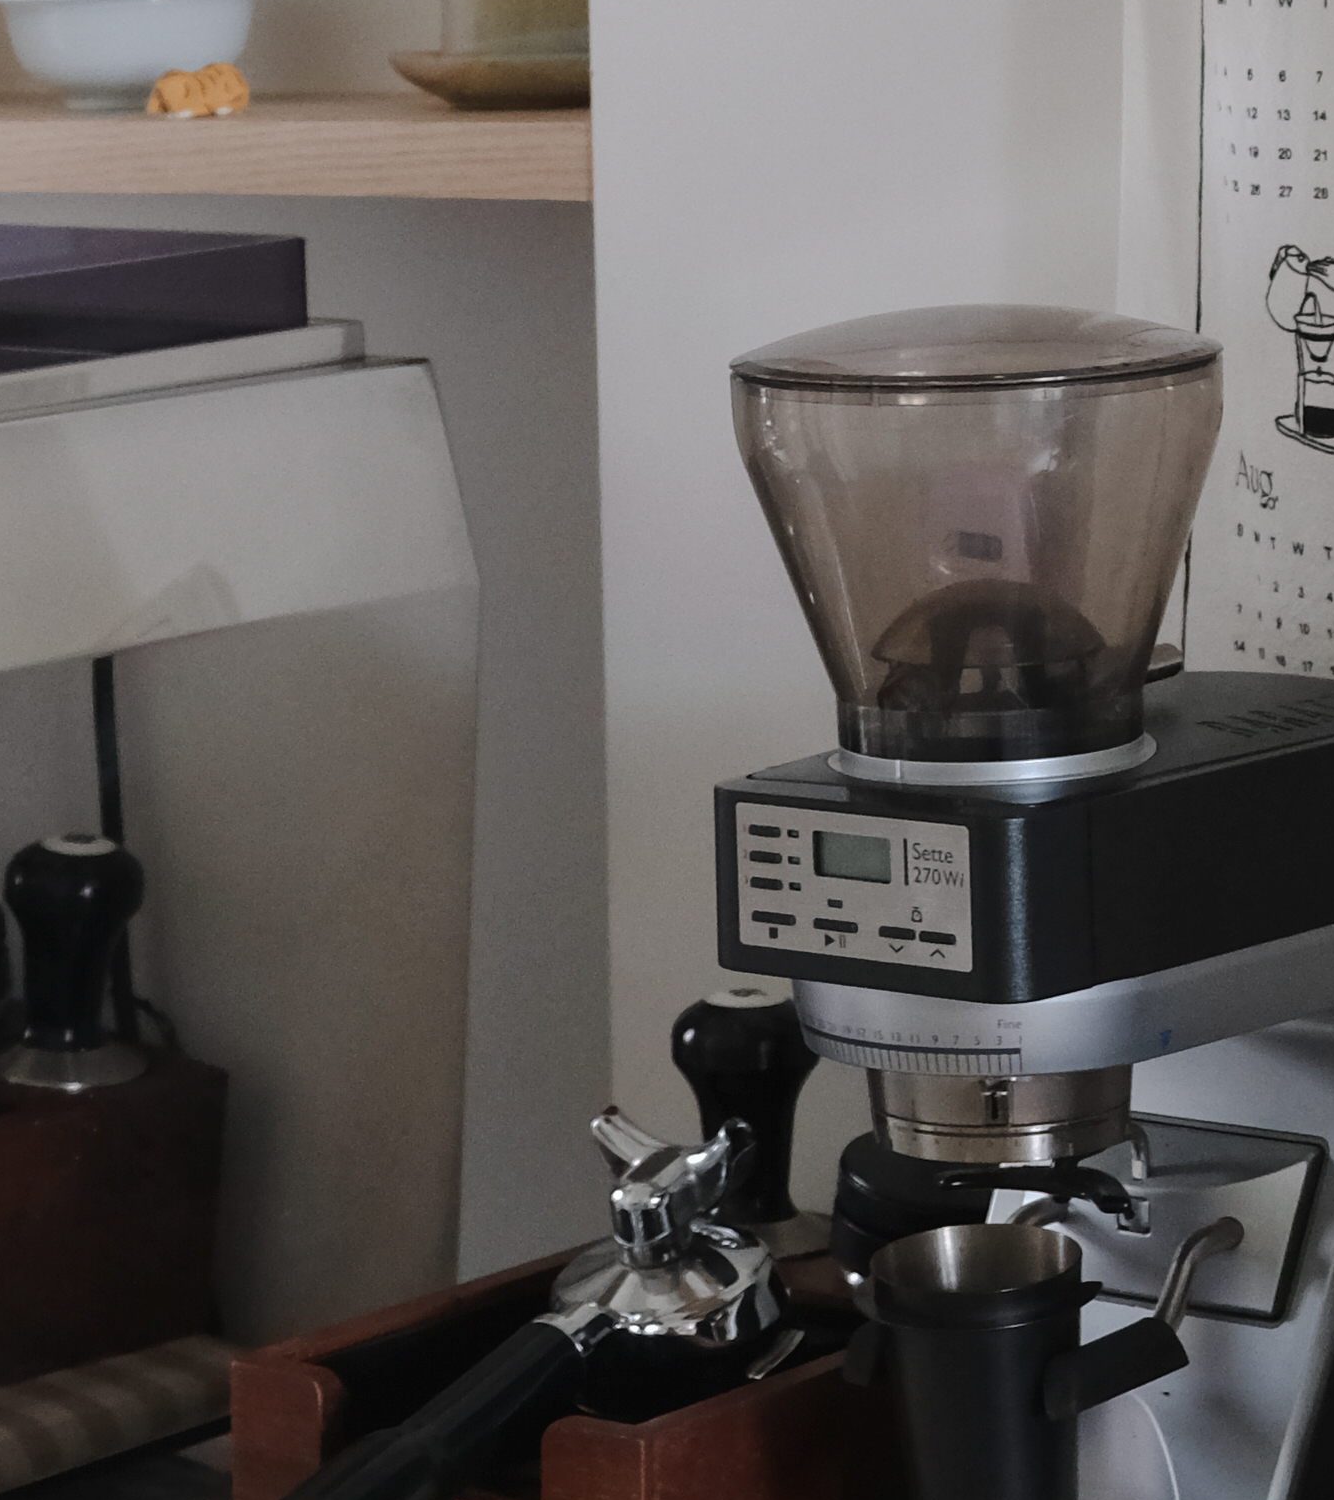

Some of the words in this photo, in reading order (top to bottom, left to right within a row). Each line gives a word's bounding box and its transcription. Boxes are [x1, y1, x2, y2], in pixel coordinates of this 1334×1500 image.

[1278, 148, 1292, 160] 20
[1313, 149, 1327, 161] 21
[911, 842, 955, 865] Sette
[997, 1018, 1024, 1031] Fine
